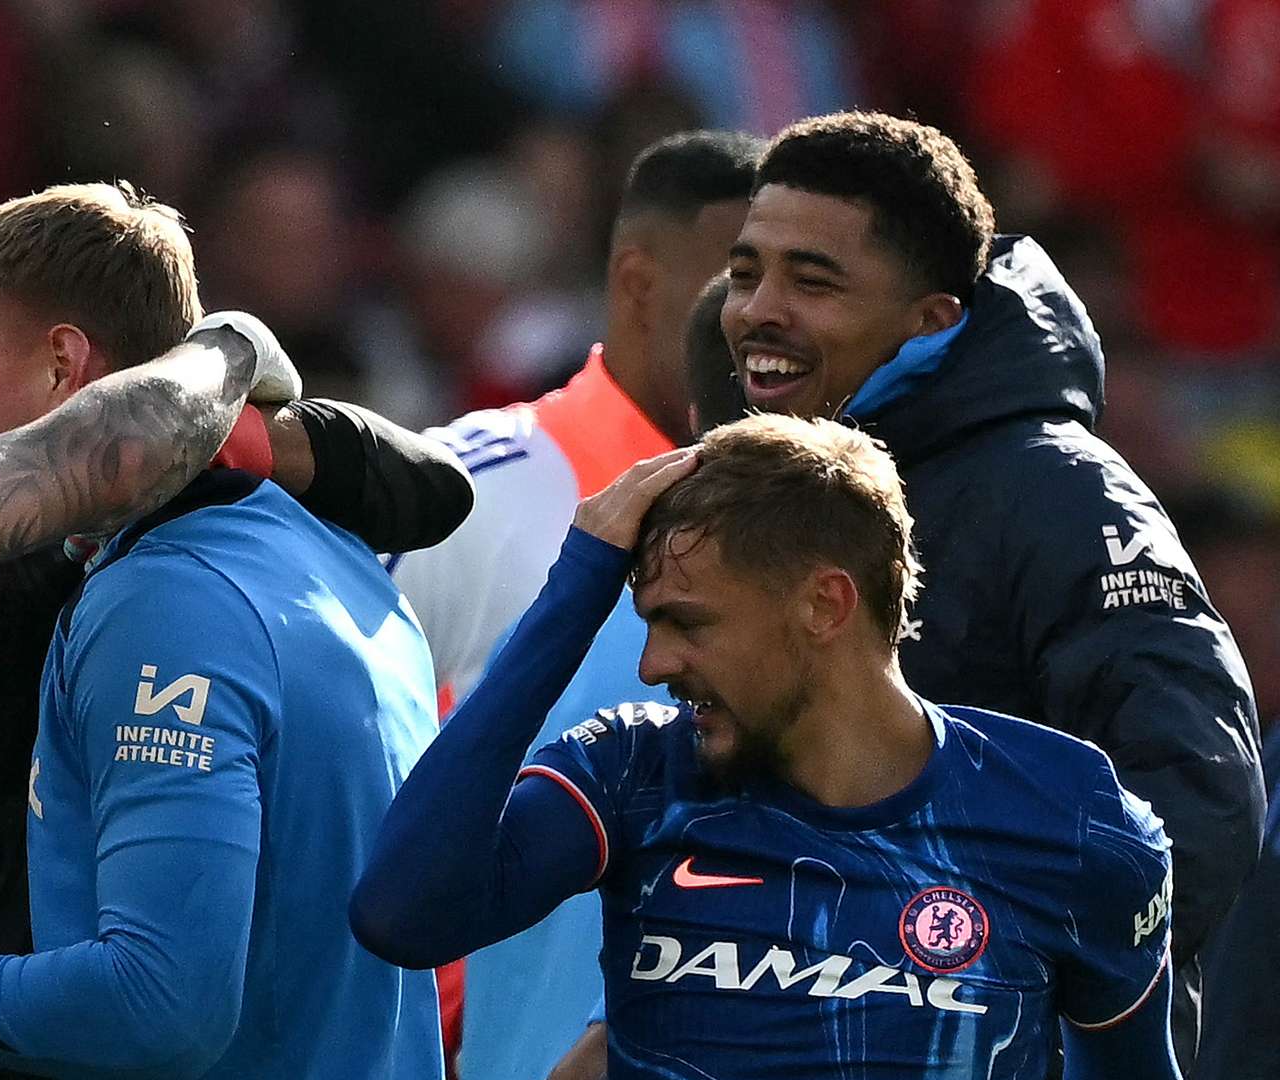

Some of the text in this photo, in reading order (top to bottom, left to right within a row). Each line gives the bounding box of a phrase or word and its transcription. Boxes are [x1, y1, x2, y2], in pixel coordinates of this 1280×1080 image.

[1101, 569, 1185, 595] INFINITE
[116, 725, 215, 754] INFINITE
[114, 745, 213, 772] ATHLETE
[922, 891, 976, 914] CHELSEA
[630, 934, 988, 1014] DAMAC
